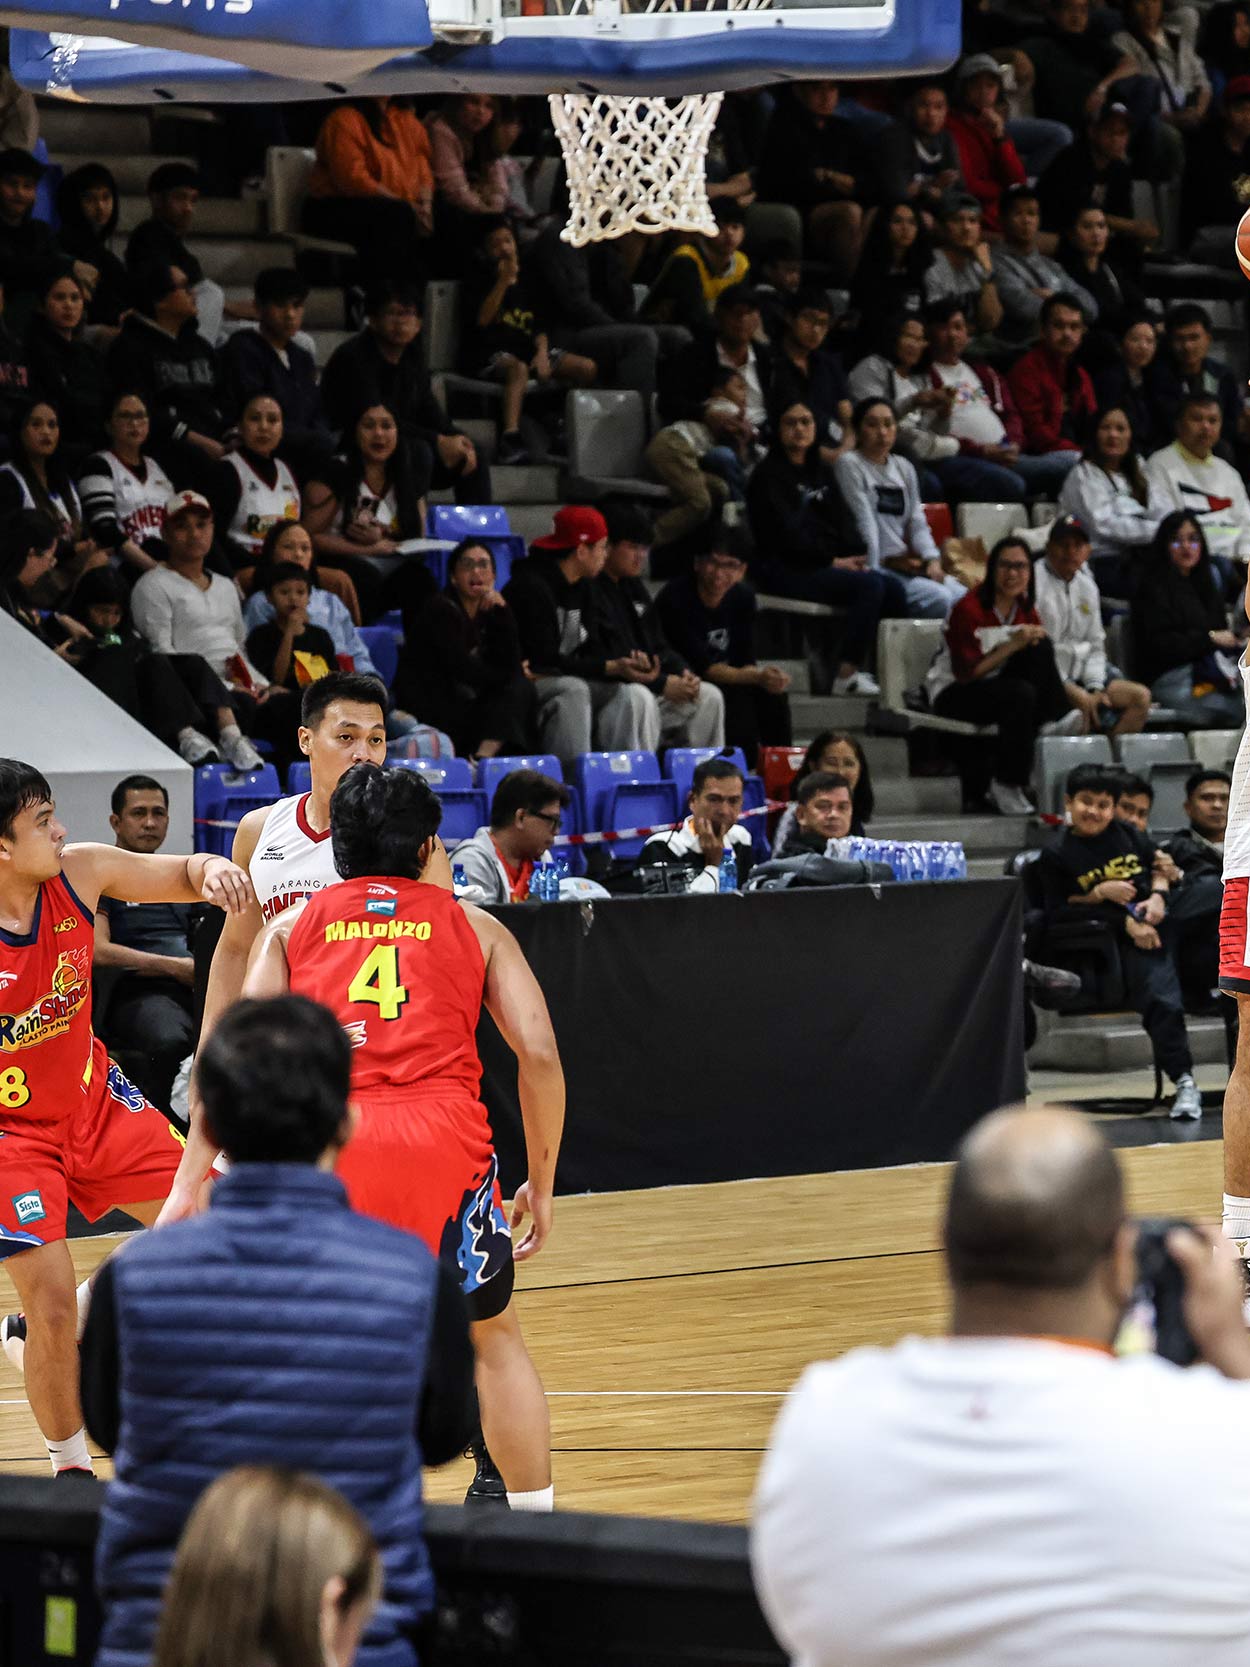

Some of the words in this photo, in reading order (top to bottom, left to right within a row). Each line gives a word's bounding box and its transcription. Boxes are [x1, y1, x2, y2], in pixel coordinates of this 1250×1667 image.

[324, 919, 432, 944] MALONZO
[348, 943, 410, 1021] 4
[19, 1200, 41, 1213] Sista
